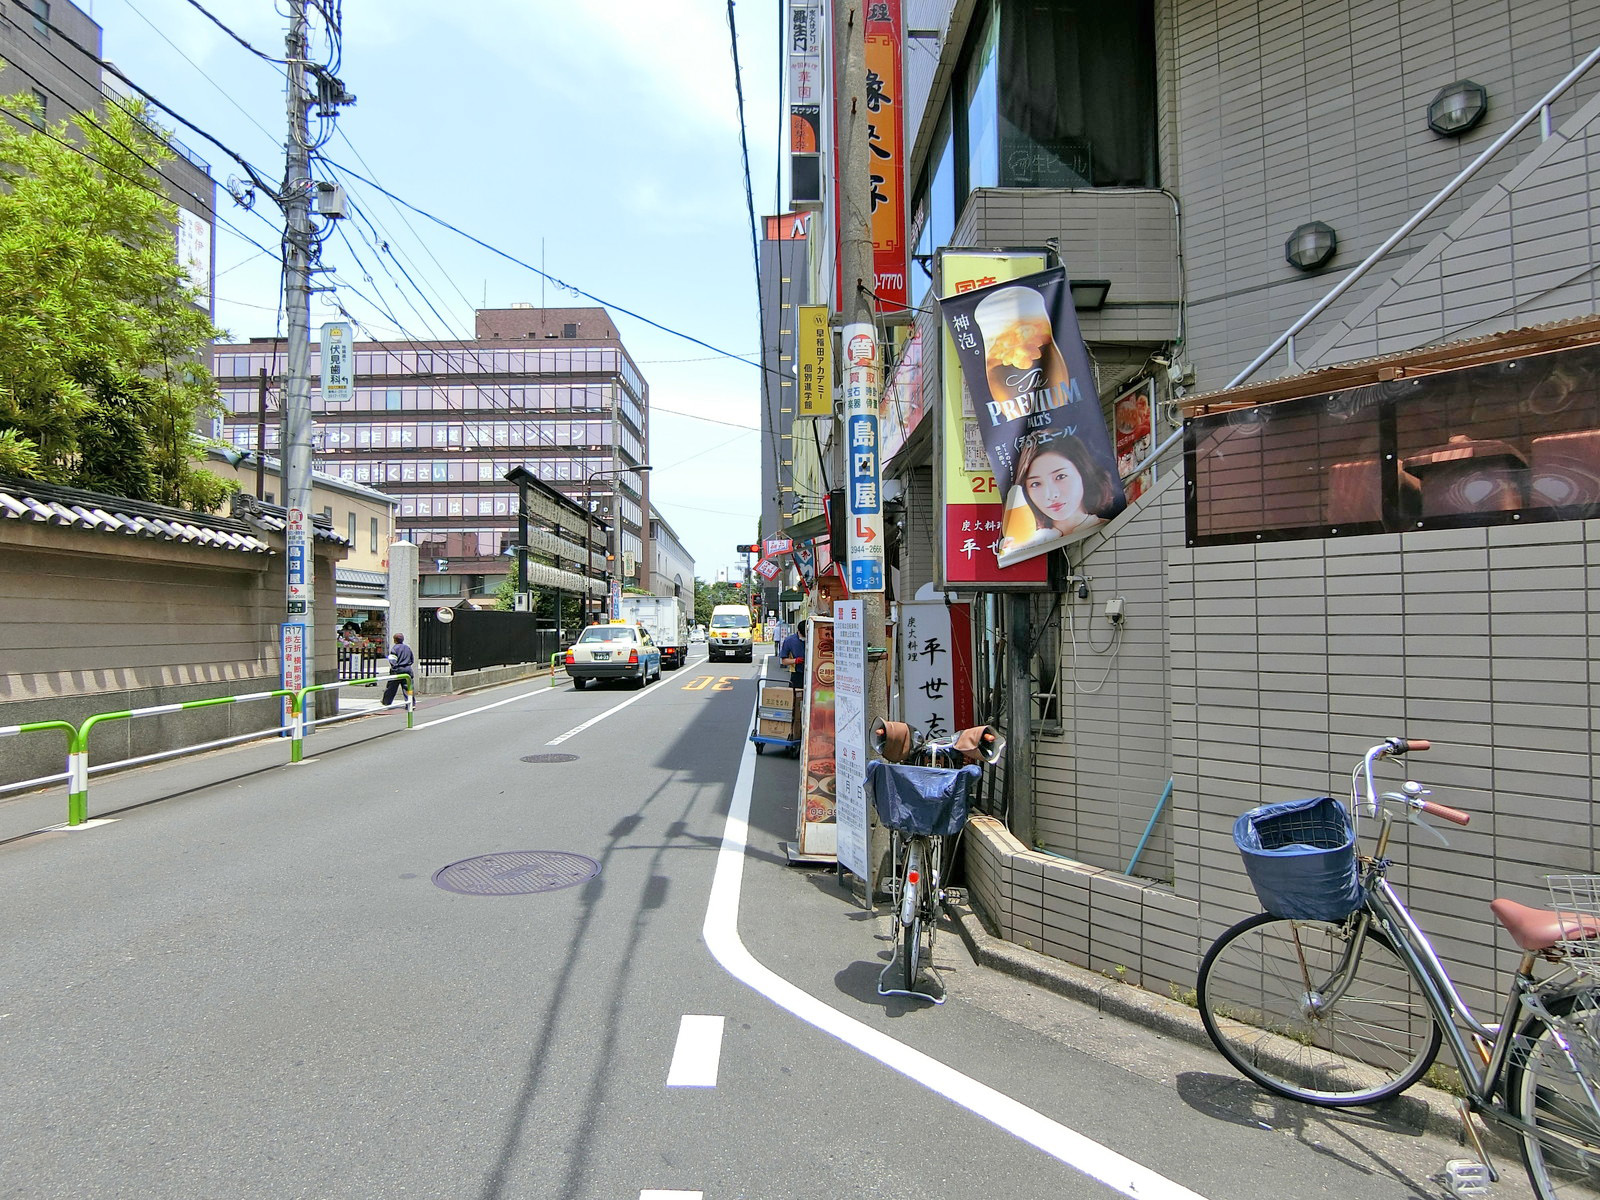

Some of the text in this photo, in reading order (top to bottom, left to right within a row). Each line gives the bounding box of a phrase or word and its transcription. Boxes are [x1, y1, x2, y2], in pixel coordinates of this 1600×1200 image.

[791, 106, 819, 114] スナック
[952, 313, 980, 356] 神泡。
[329, 344, 341, 385] 伏見歯科
[803, 363, 813, 410] 個別進学館
[816, 328, 825, 400] 早稲田アカデミー
[849, 371, 875, 384] 買取
[985, 377, 1084, 427] PREMIUM
[852, 420, 878, 509] 島田屋
[285, 626, 302, 635] R17
[293, 636, 302, 652] 左折
[907, 616, 919, 662] 炭火料理
[284, 635, 293, 715] 歩行者・自転注意
[918, 637, 948, 741] 平世志
